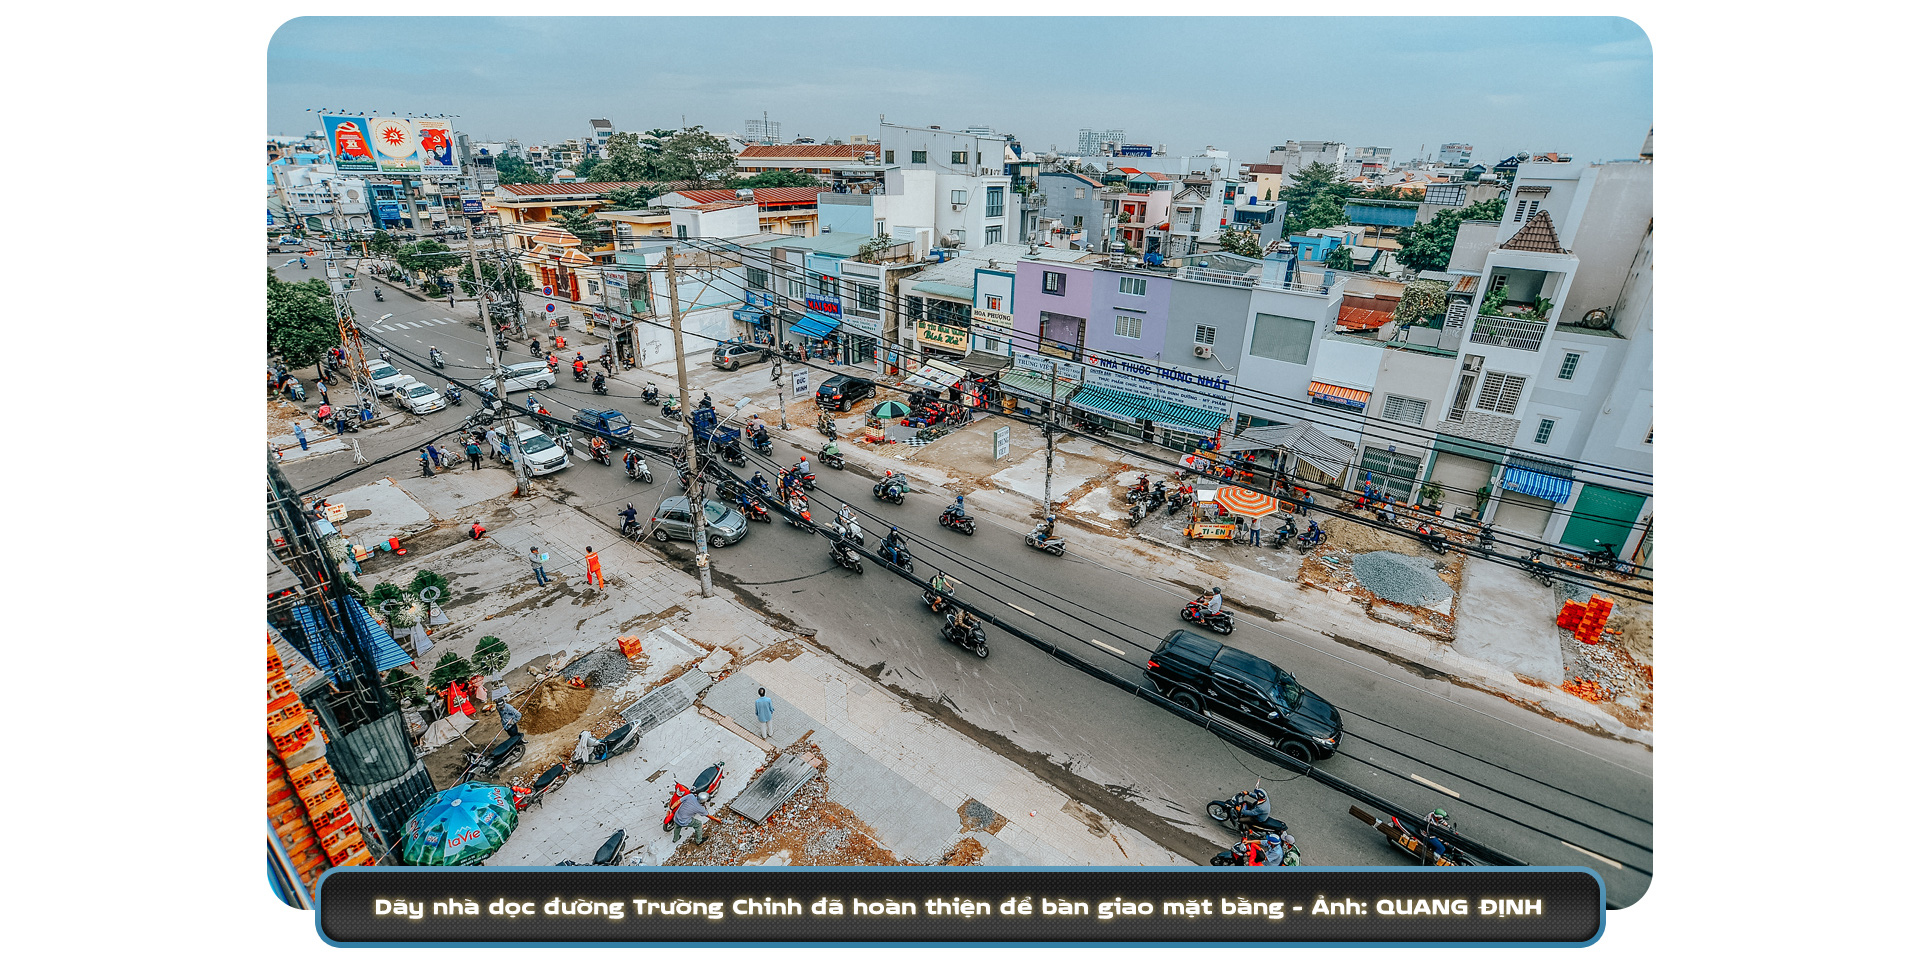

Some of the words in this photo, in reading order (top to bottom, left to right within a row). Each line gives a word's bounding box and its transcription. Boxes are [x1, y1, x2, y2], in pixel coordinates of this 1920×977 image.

[808, 300, 822, 311] MAI
[987, 312, 1011, 321] PHƯỢNG
[1017, 358, 1038, 368] TRUNG
[1039, 363, 1053, 372] VIỆT
[1100, 358, 1118, 370] NHÀ
[1155, 366, 1193, 384] THỐNG
[1197, 375, 1230, 391] NHẤT
[1215, 528, 1226, 536] EN
[447, 830, 481, 848] laVie
